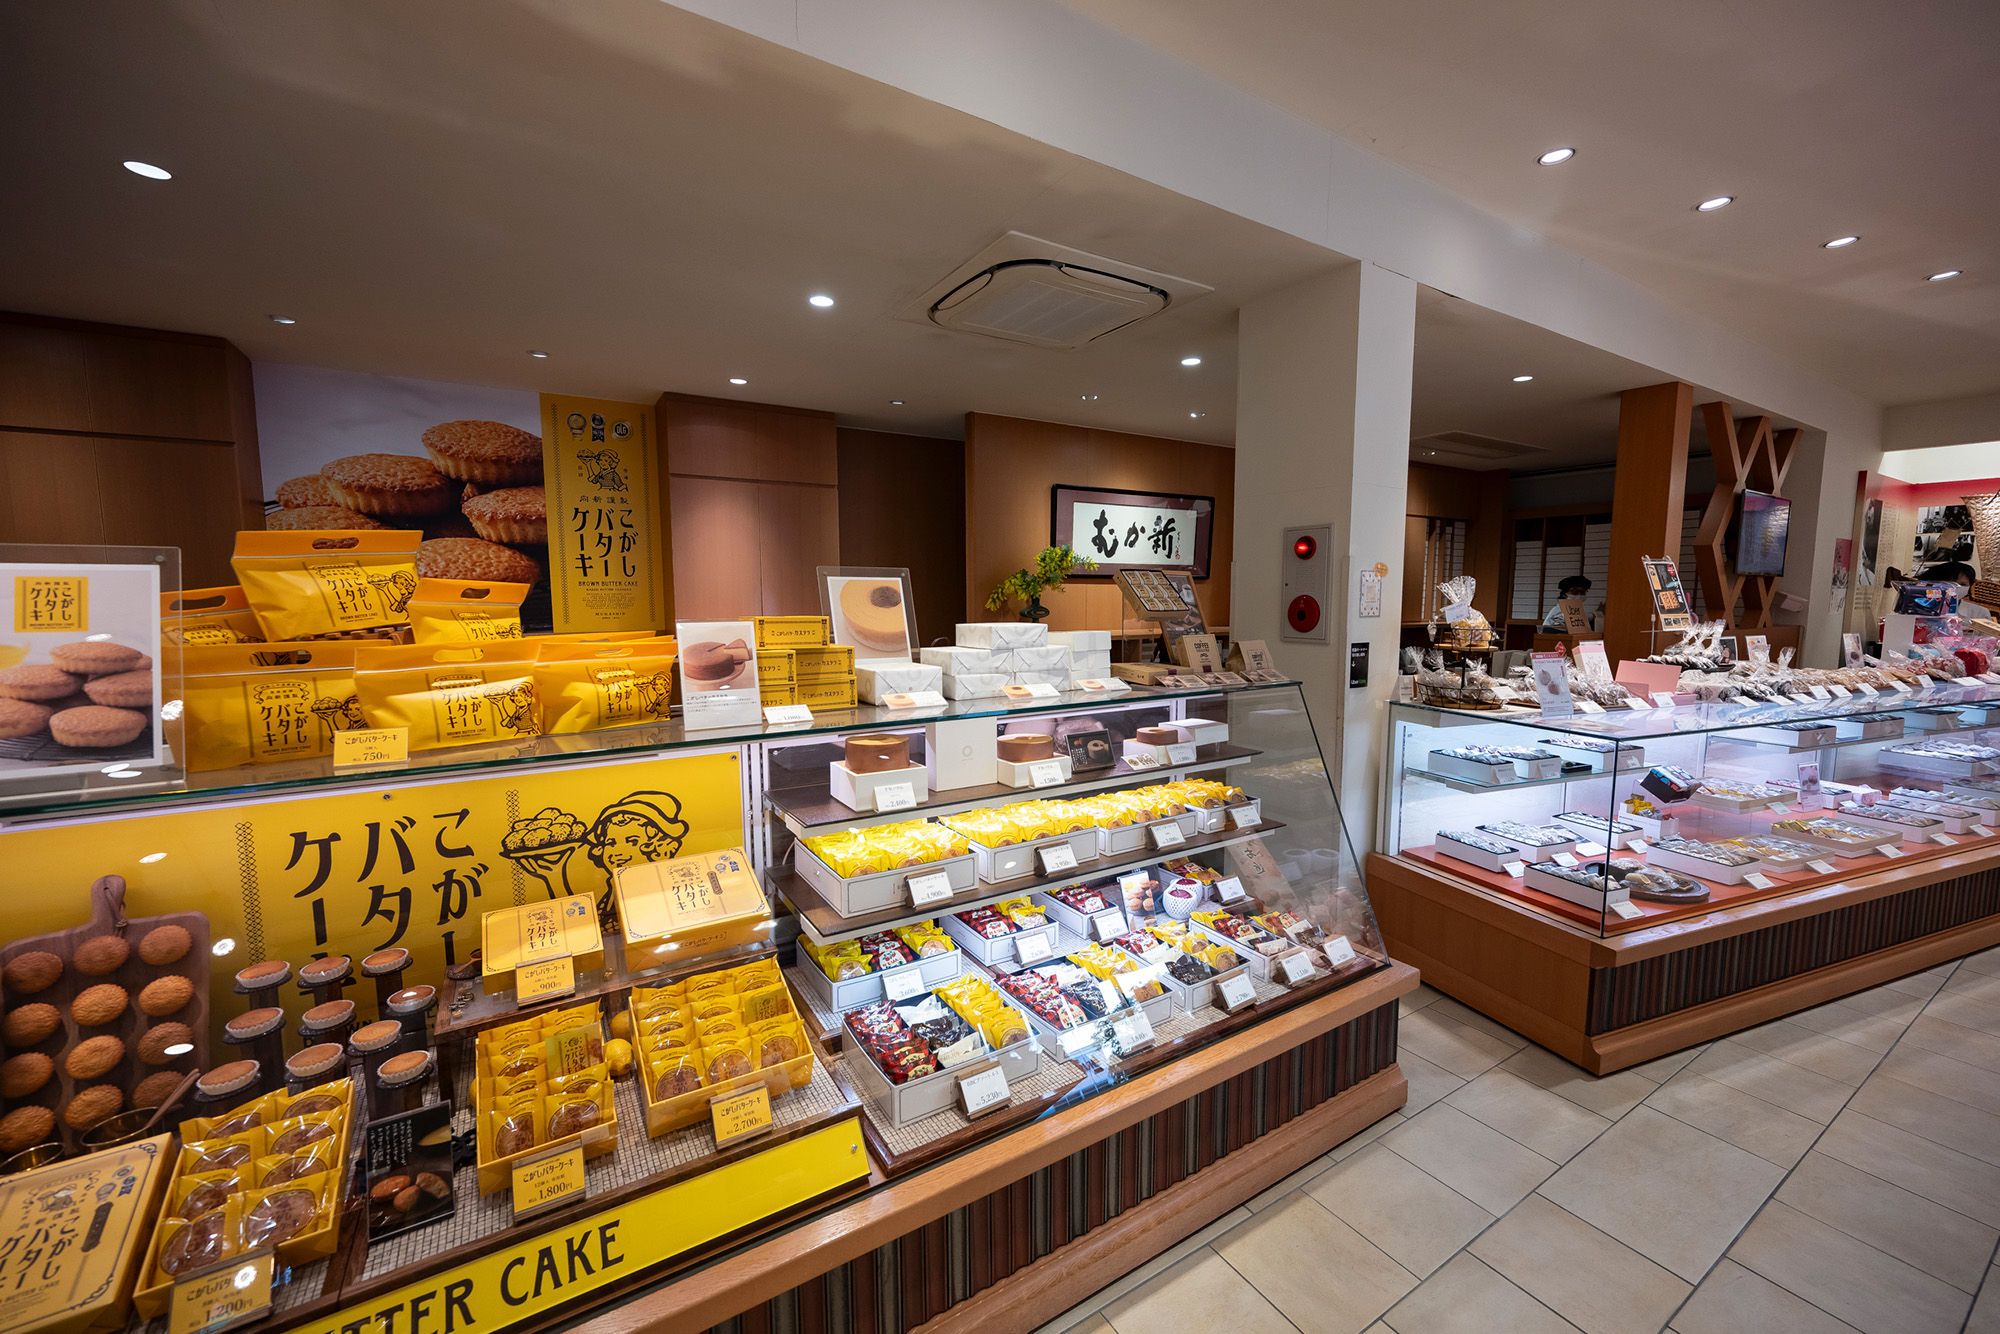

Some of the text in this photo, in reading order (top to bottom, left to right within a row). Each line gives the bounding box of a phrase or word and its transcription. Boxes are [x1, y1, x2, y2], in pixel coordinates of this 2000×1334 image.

[571, 507, 593, 577] ケーキ
[594, 508, 614, 577] バター
[619, 509, 639, 577] こがし
[30, 588, 43, 621] ケーキ
[44, 588, 58, 621] バター
[61, 587, 75, 621] こがし
[326, 579, 348, 614] ケーキ
[340, 578, 358, 612] バター
[353, 577, 372, 611] こがし
[1566, 606, 1580, 616] Uber
[1569, 616, 1585, 627] Eats
[276, 704, 291, 745] バター
[294, 702, 309, 744] こがし
[442, 694, 458, 729] ケーキ
[456, 692, 468, 726] バター
[470, 691, 482, 726] こがし
[260, 706, 277, 747] ケーキ
[345, 734, 398, 745] こがしバターケーキ
[363, 752, 390, 761] 750円
[357, 816, 417, 952] バタ
[672, 885, 687, 911] ケーキ
[684, 882, 696, 908] バター
[697, 880, 711, 906] こがし
[526, 927, 537, 950] ケーキ
[536, 924, 547, 947] バター
[548, 922, 558, 945] こがし
[525, 964, 566, 979] こがしバターケーキ
[540, 981, 562, 990] 900円
[720, 1096, 762, 1117] こがしバターケーキ
[980, 1091, 1002, 1104] 5,230円
[734, 1116, 762, 1132] 2,700円
[522, 1158, 574, 1183] こがしバターケーキ
[539, 1182, 573, 1200] 1,800円
[16, 1222, 57, 1290] バター
[41, 1215, 80, 1280] こがし
[500, 1219, 625, 1307] CAKE
[205, 1298, 254, 1322] 1200円
